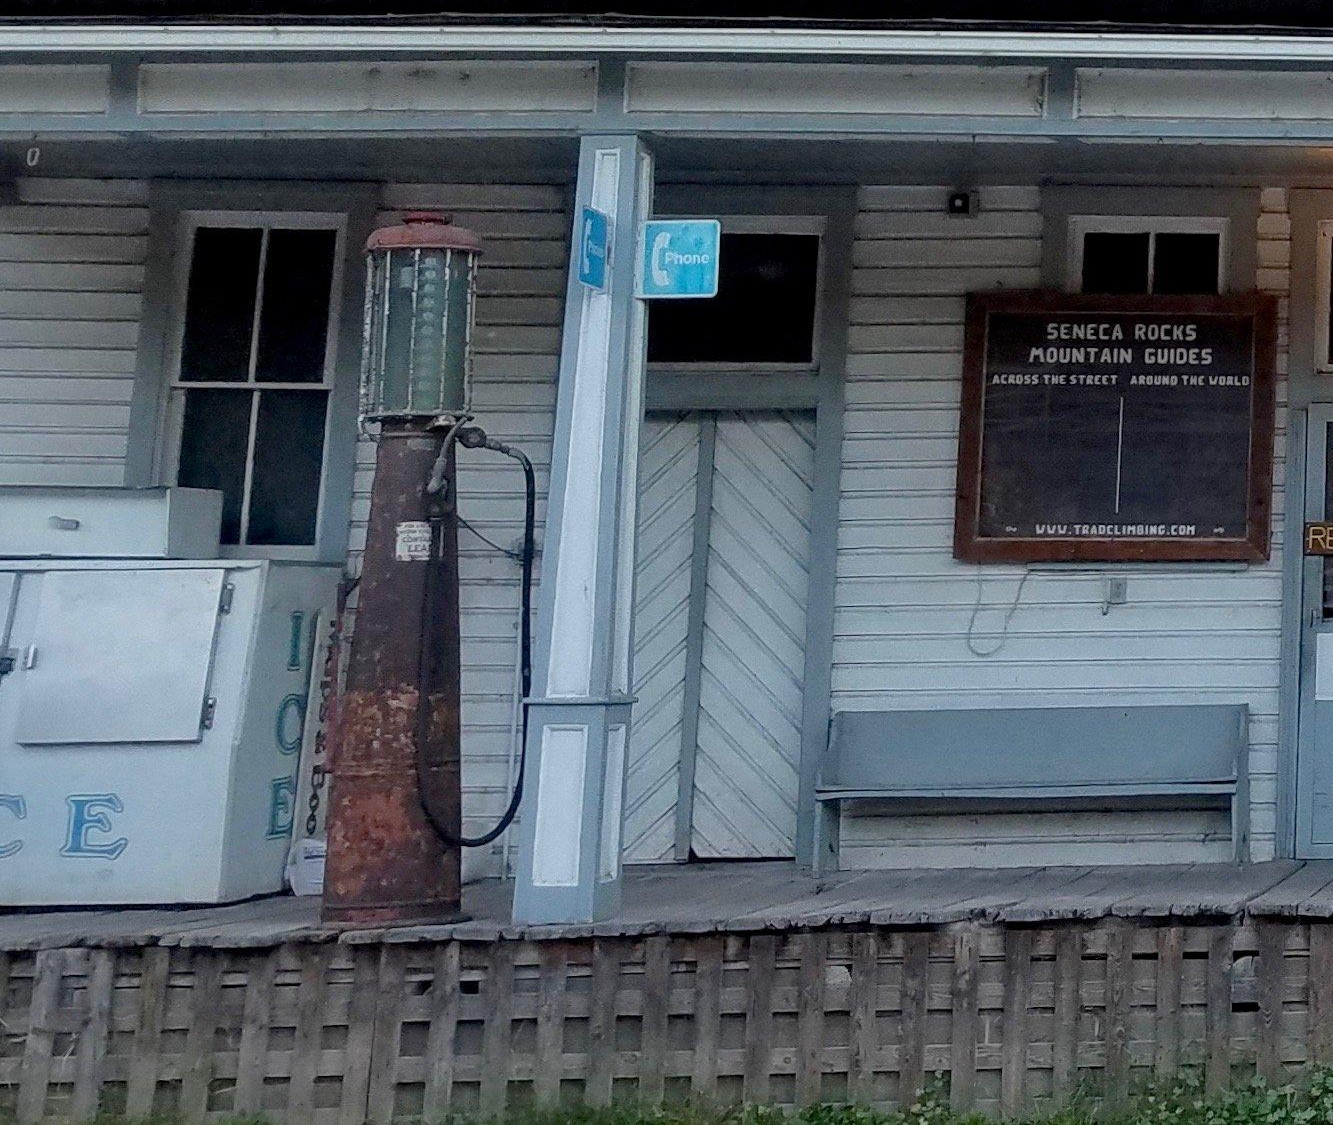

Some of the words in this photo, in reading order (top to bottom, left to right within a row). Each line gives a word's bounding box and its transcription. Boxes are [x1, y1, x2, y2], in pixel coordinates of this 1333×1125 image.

[665, 251, 710, 265] Phone
[1047, 324, 1123, 340] SENECA
[1134, 324, 1197, 341] ROCKS
[1029, 347, 1133, 364] MOUNTAIN
[1144, 348, 1213, 365] GUIDES
[992, 374, 1039, 385] ACROSS
[1042, 375, 1066, 385] THE
[1069, 374, 1118, 386] STREET
[1130, 375, 1178, 386] AROUND
[1182, 375, 1205, 386] THE
[1209, 375, 1250, 386] WORLD
[1035, 524, 1196, 536] WWW.TRADCLIMBING.COM
